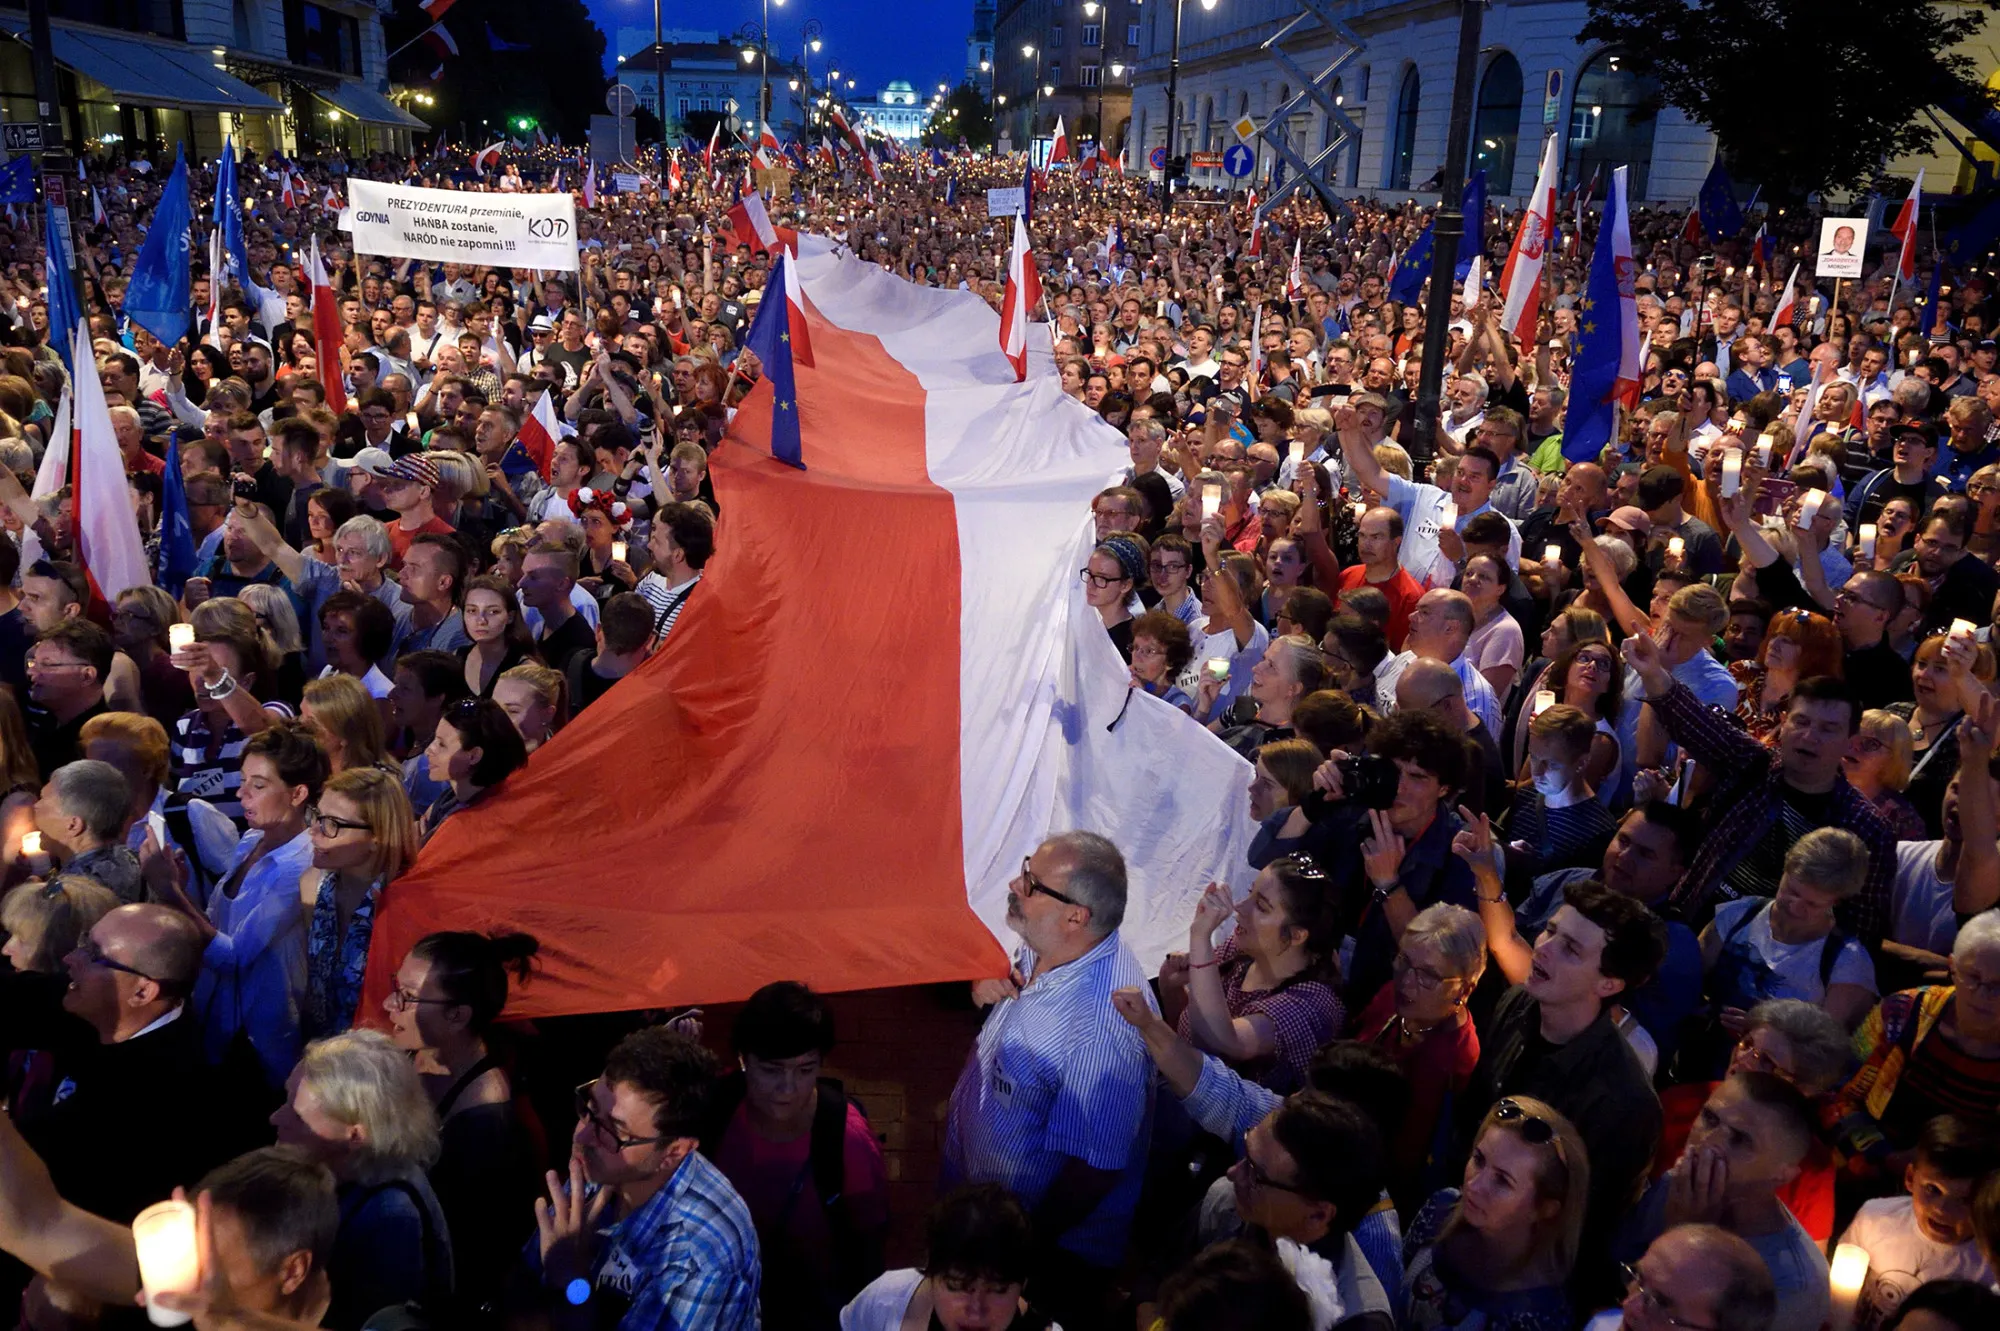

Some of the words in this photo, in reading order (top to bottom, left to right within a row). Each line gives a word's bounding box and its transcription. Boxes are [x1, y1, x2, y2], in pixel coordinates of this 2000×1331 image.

[356, 211, 390, 225] GDYNIA
[388, 198, 468, 215] PREZYDENTURA
[470, 207, 525, 220] przeminie,
[413, 216, 449, 230] HAŃBA
[450, 222, 498, 235] zostanie,
[528, 218, 569, 239] KOD
[403, 231, 438, 246] NARÓD
[440, 235, 456, 247] nie
[457, 239, 504, 252] zapomni
[505, 240, 516, 251] !!!
[1180, 674, 1199, 687] VETO
[193, 772, 224, 795] VETO
